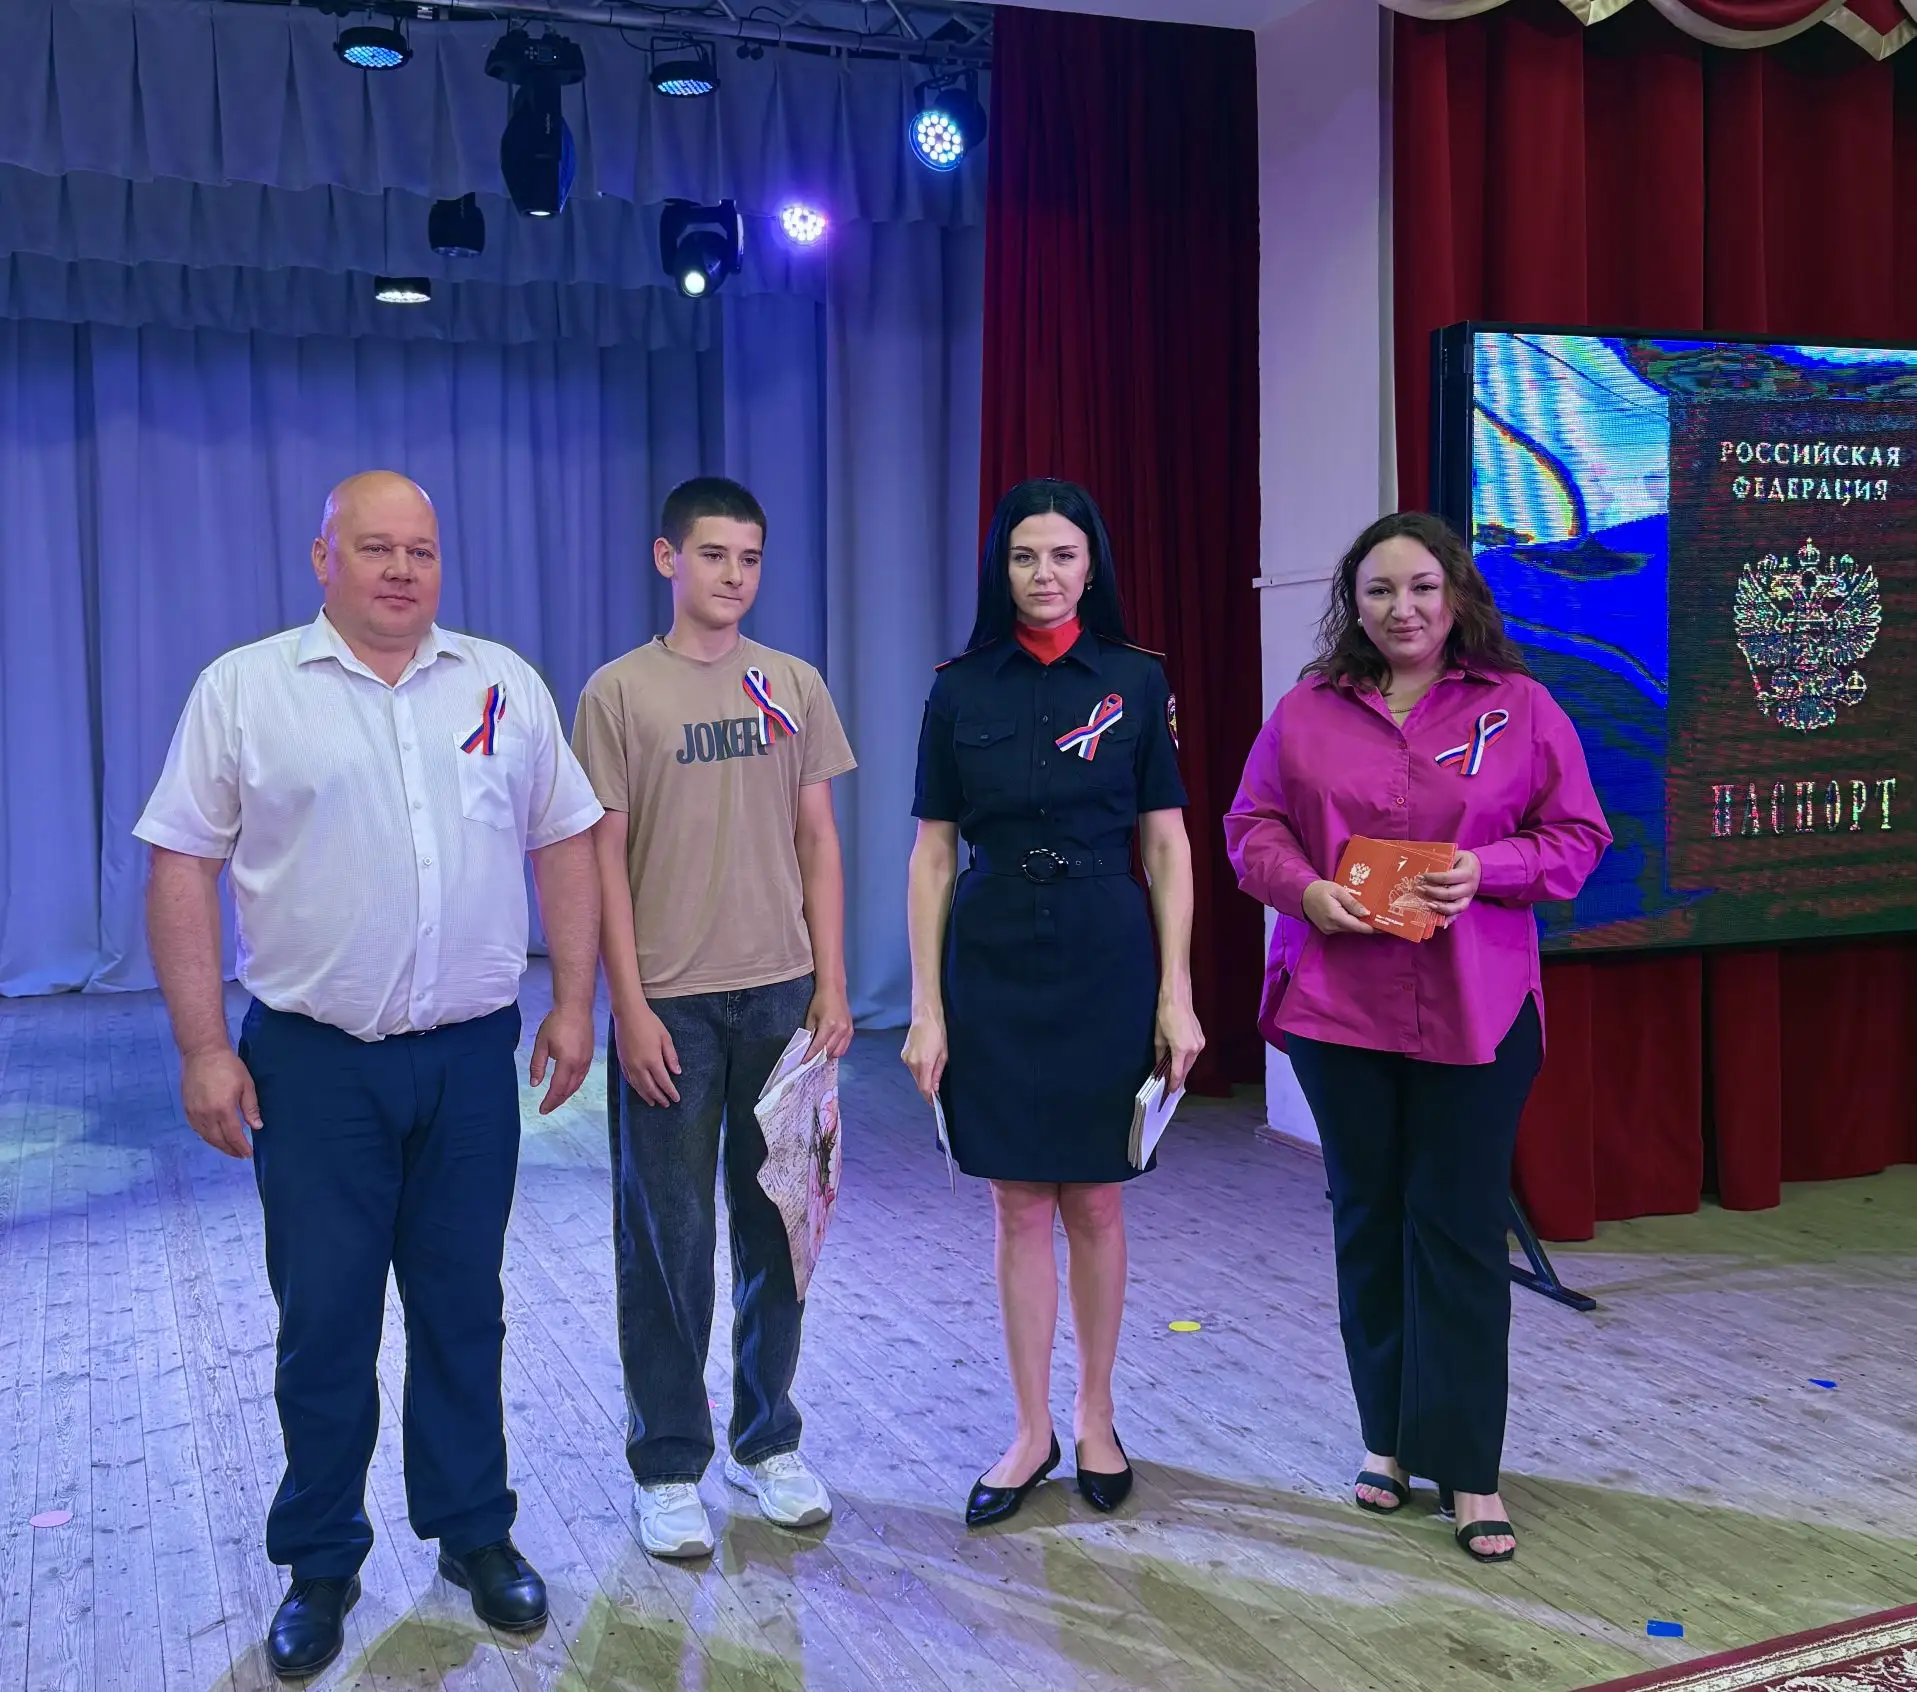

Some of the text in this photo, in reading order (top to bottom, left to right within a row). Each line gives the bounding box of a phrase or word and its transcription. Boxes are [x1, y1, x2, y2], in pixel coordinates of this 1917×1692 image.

[1720, 441, 1900, 467] РОССИЙСКАЯ
[1732, 475, 1888, 506] ФЕДЕРАЦИЯ
[676, 717, 769, 765] JOKER
[1711, 778, 1896, 837] ПАСПОРТ
